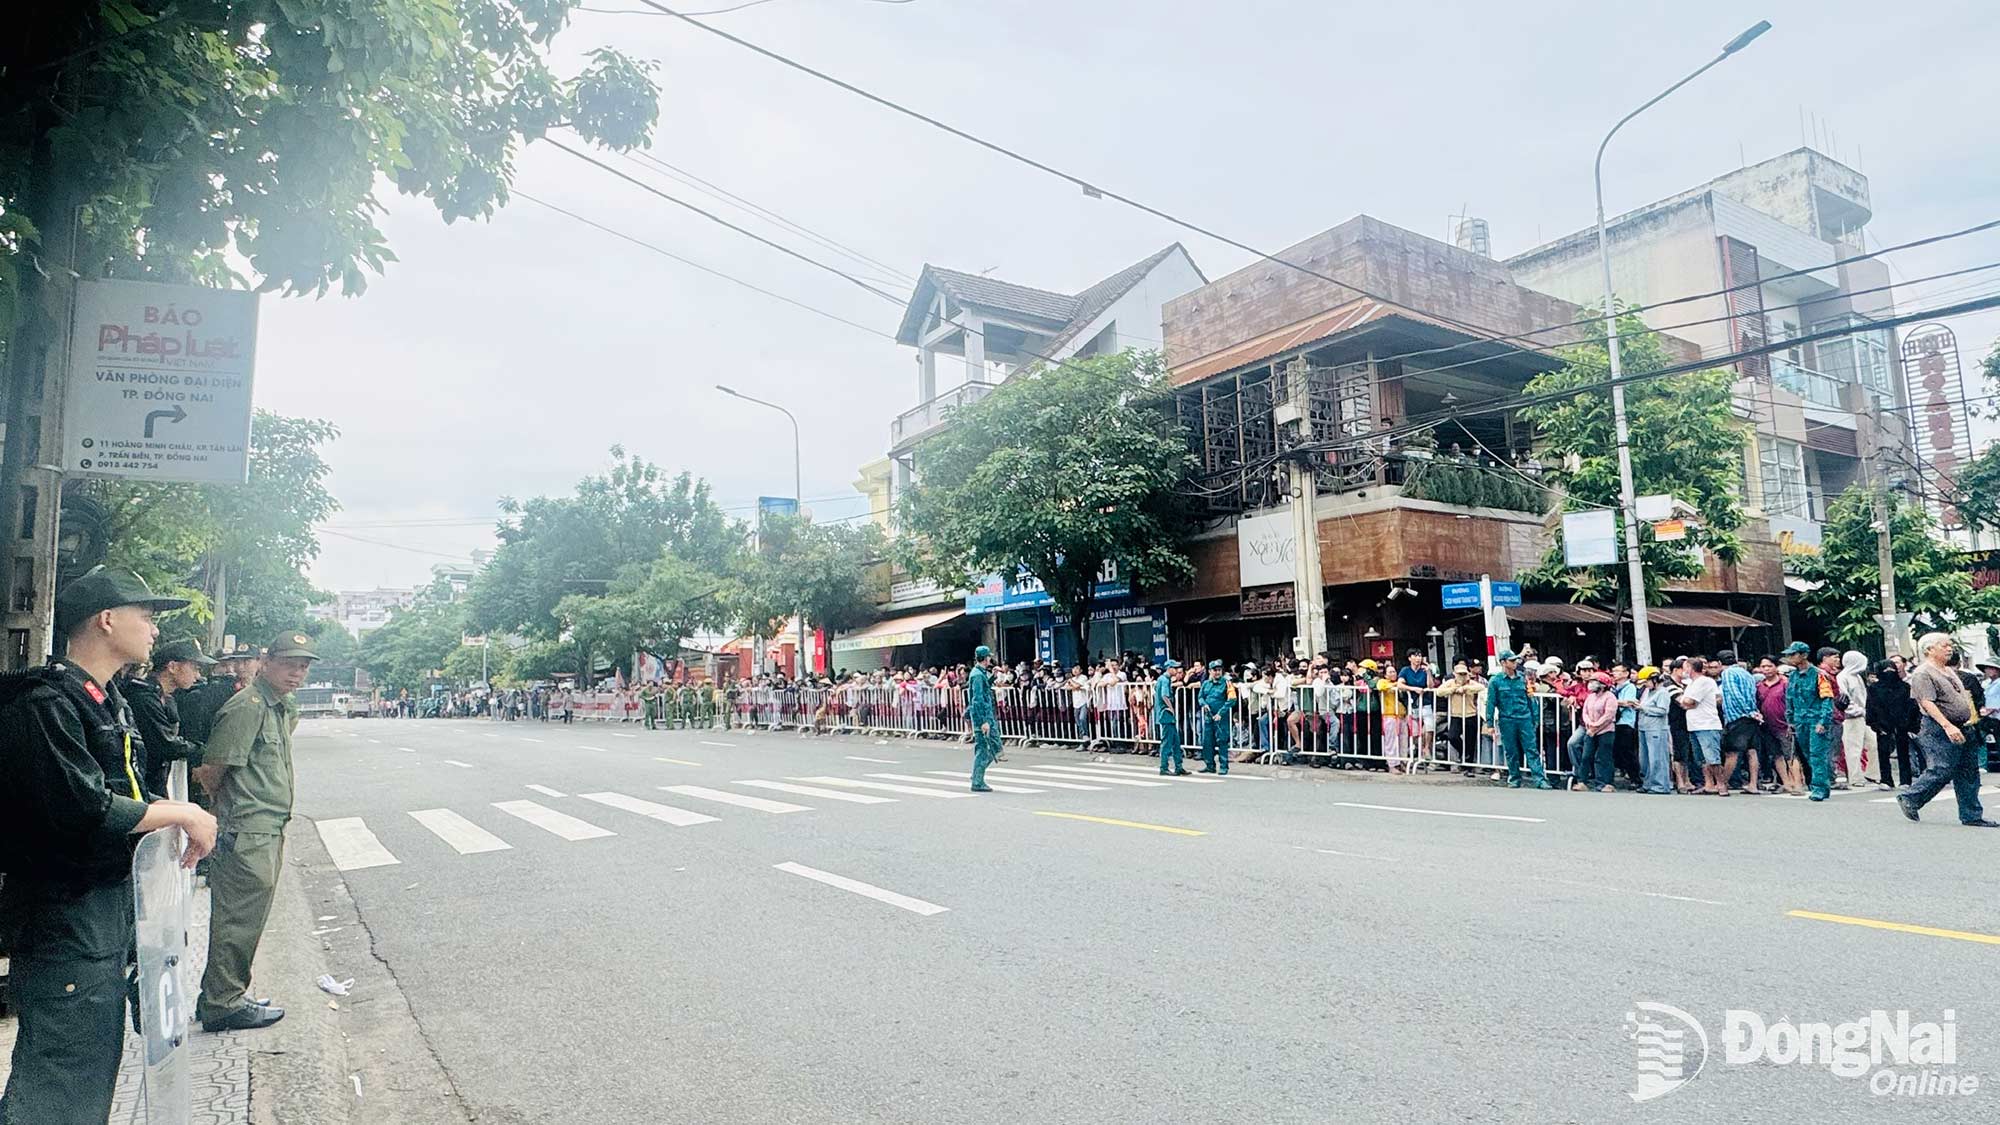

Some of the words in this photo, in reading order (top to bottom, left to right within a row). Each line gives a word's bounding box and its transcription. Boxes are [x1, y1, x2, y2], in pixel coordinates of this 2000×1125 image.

[144, 303, 202, 326] BÁO
[96, 370, 125, 383] VĂN
[129, 373, 179, 385] PHÒNG
[183, 375, 208, 388] ĐẠI
[143, 387, 186, 401] ĐỒNG
[190, 393, 214, 402] NAI
[100, 440, 109, 448] 11
